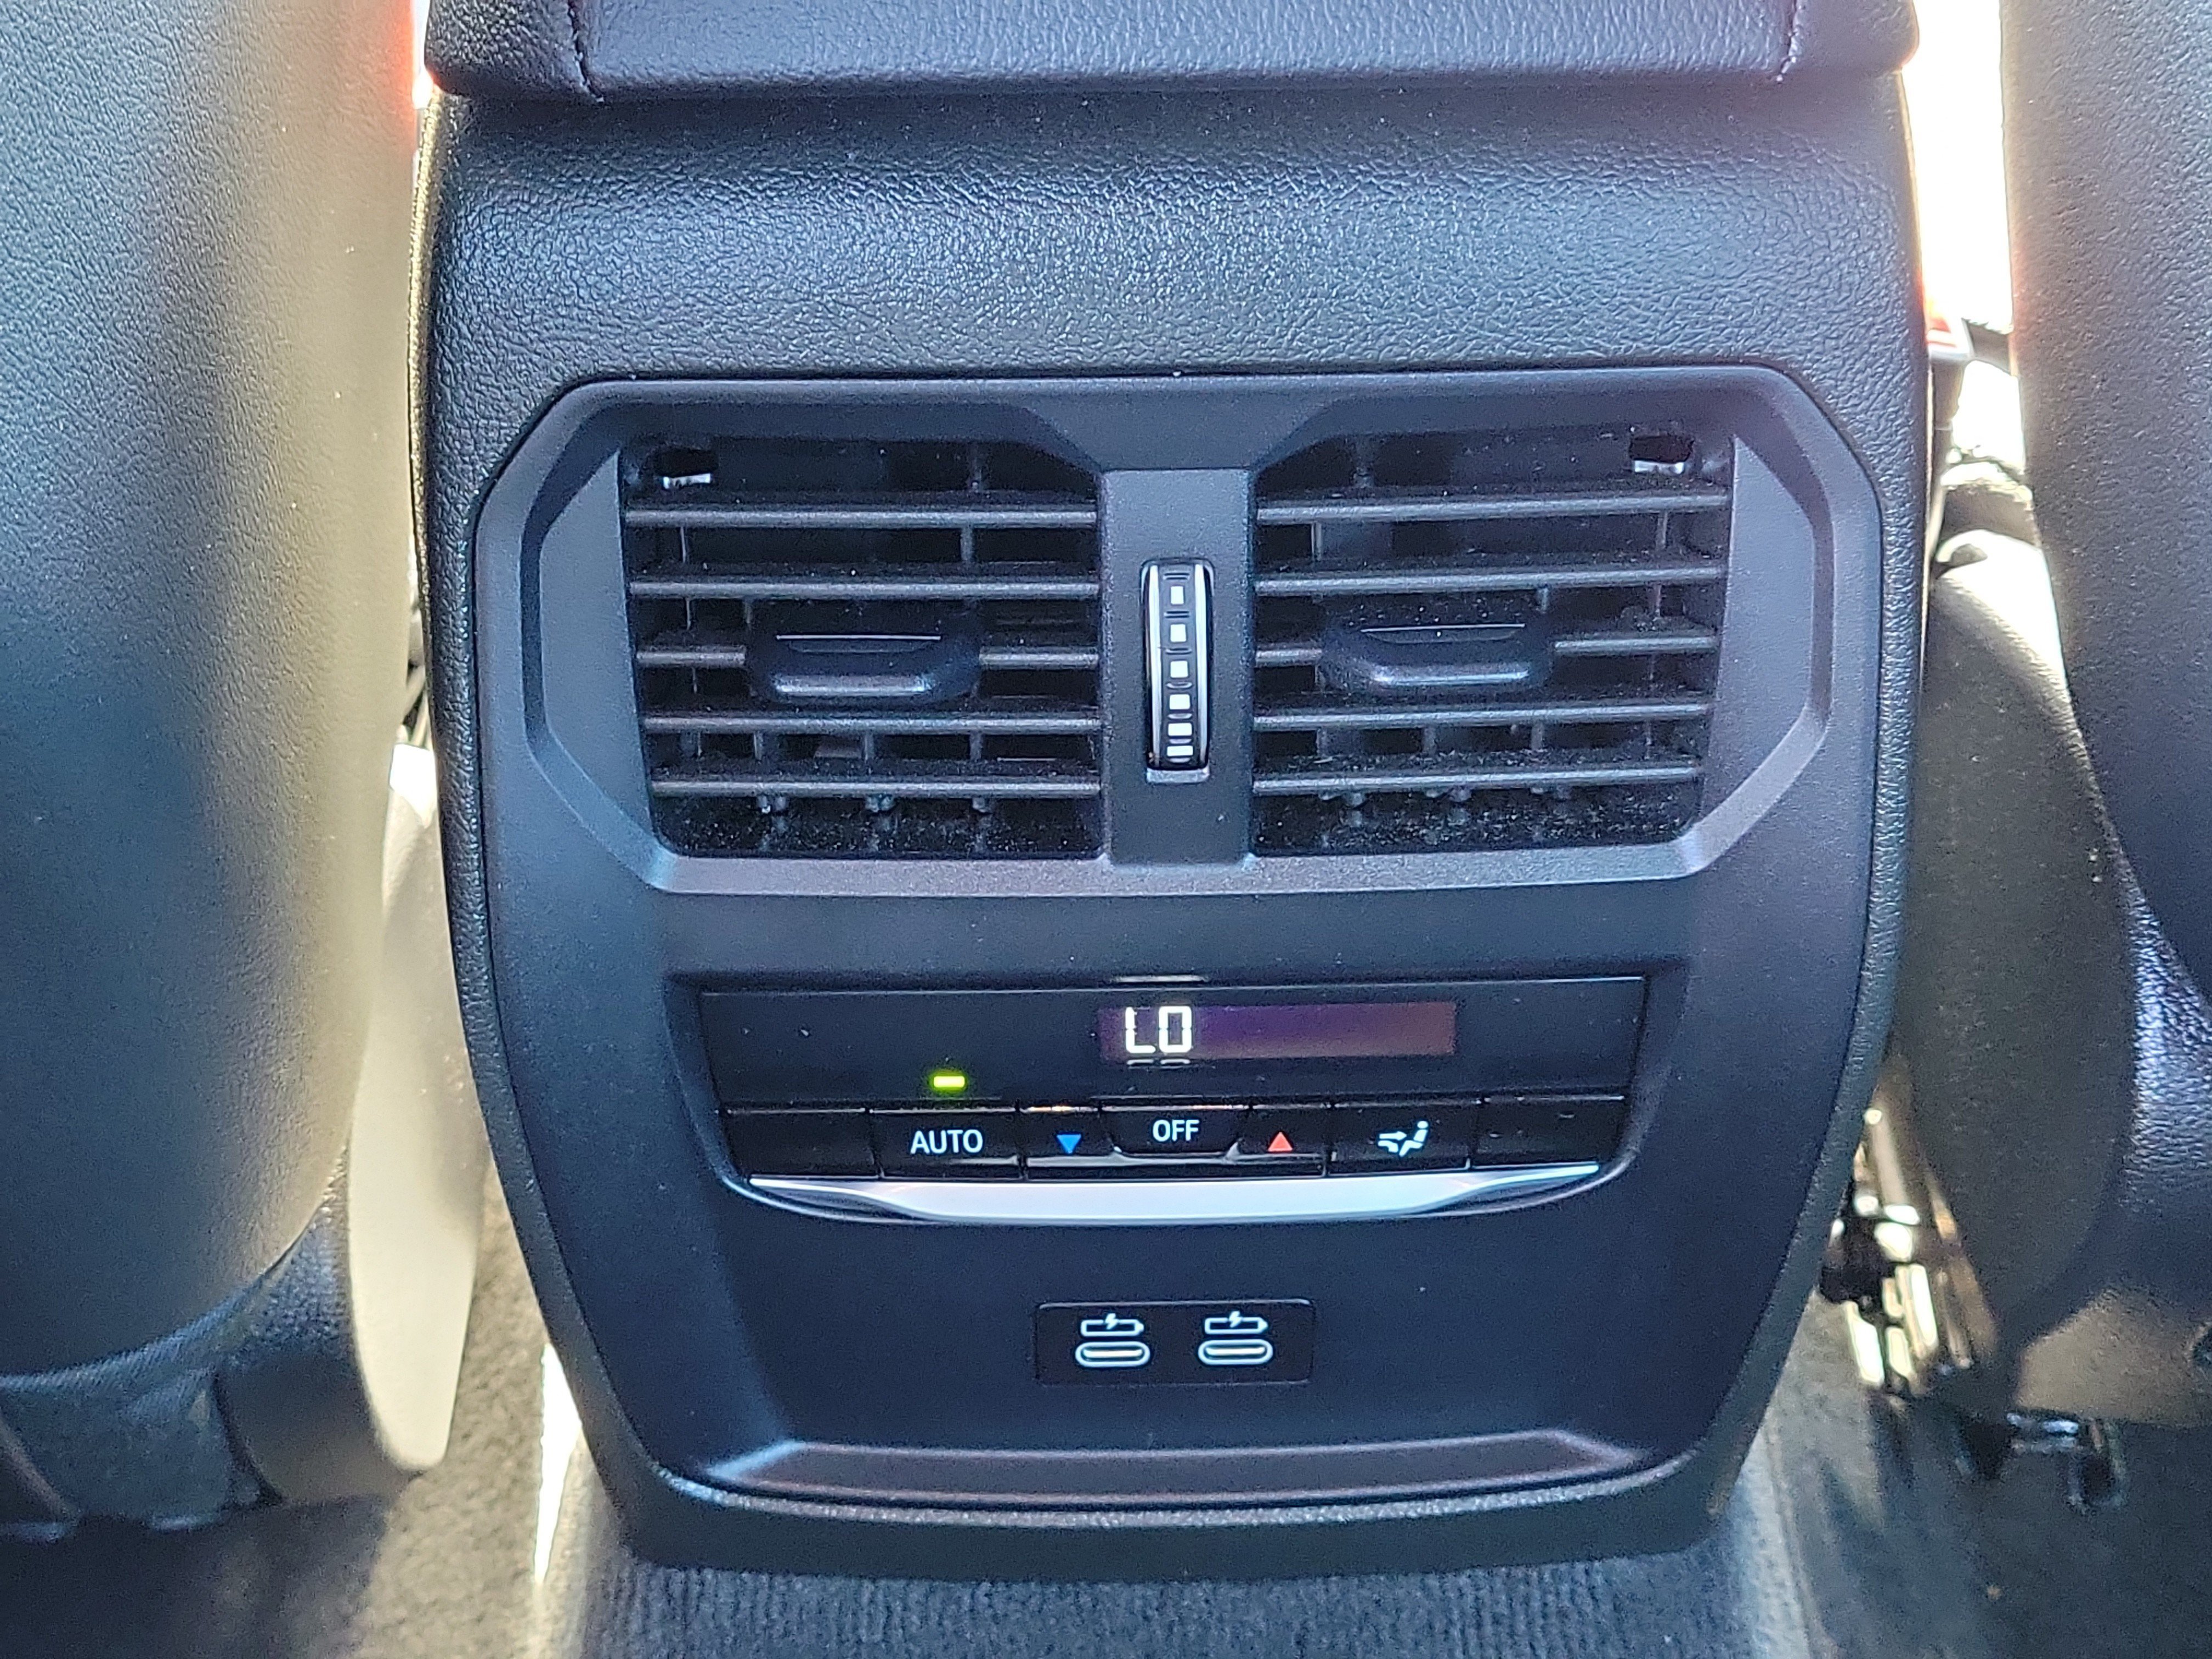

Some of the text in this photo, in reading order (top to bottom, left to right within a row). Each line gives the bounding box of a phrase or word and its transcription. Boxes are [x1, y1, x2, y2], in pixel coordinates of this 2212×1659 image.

[1125, 1006, 1193, 1054] LO
[910, 1129, 984, 1154] AUTO
[1152, 1119, 1200, 1142] OFF
